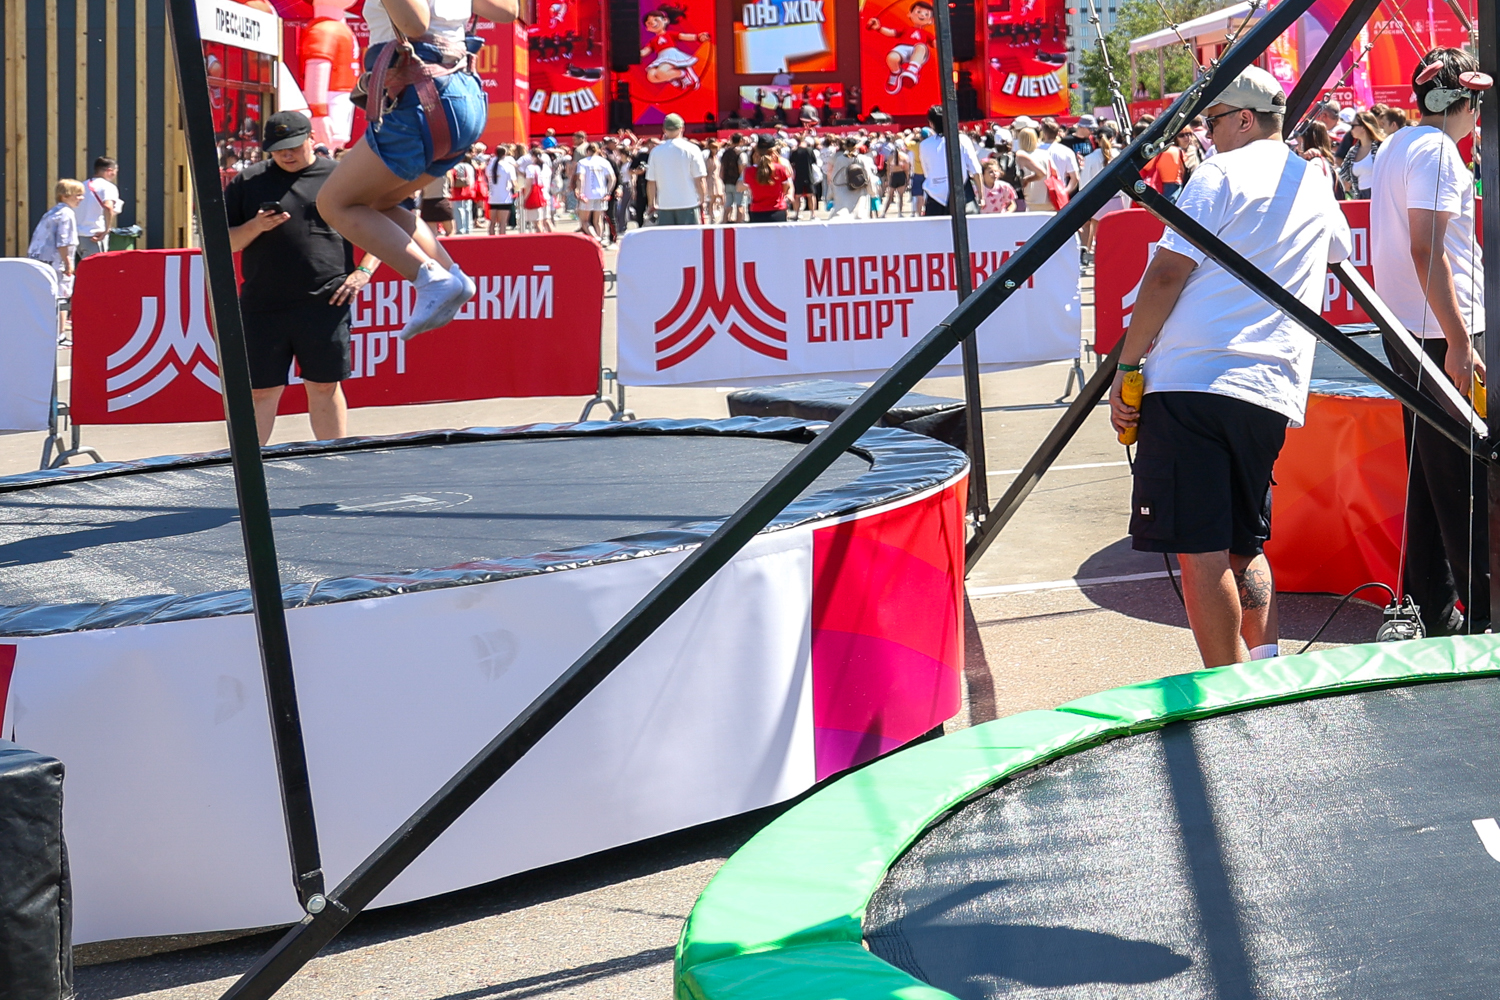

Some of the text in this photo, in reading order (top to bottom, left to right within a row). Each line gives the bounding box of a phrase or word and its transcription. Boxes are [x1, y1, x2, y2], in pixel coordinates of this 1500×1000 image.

[1002, 71, 1064, 98] В ЛЕТО!
[1330, 92, 1353, 101] ЕТО
[529, 88, 600, 116] В ЛЕТО!
[806, 299, 914, 343] СПОРТ
